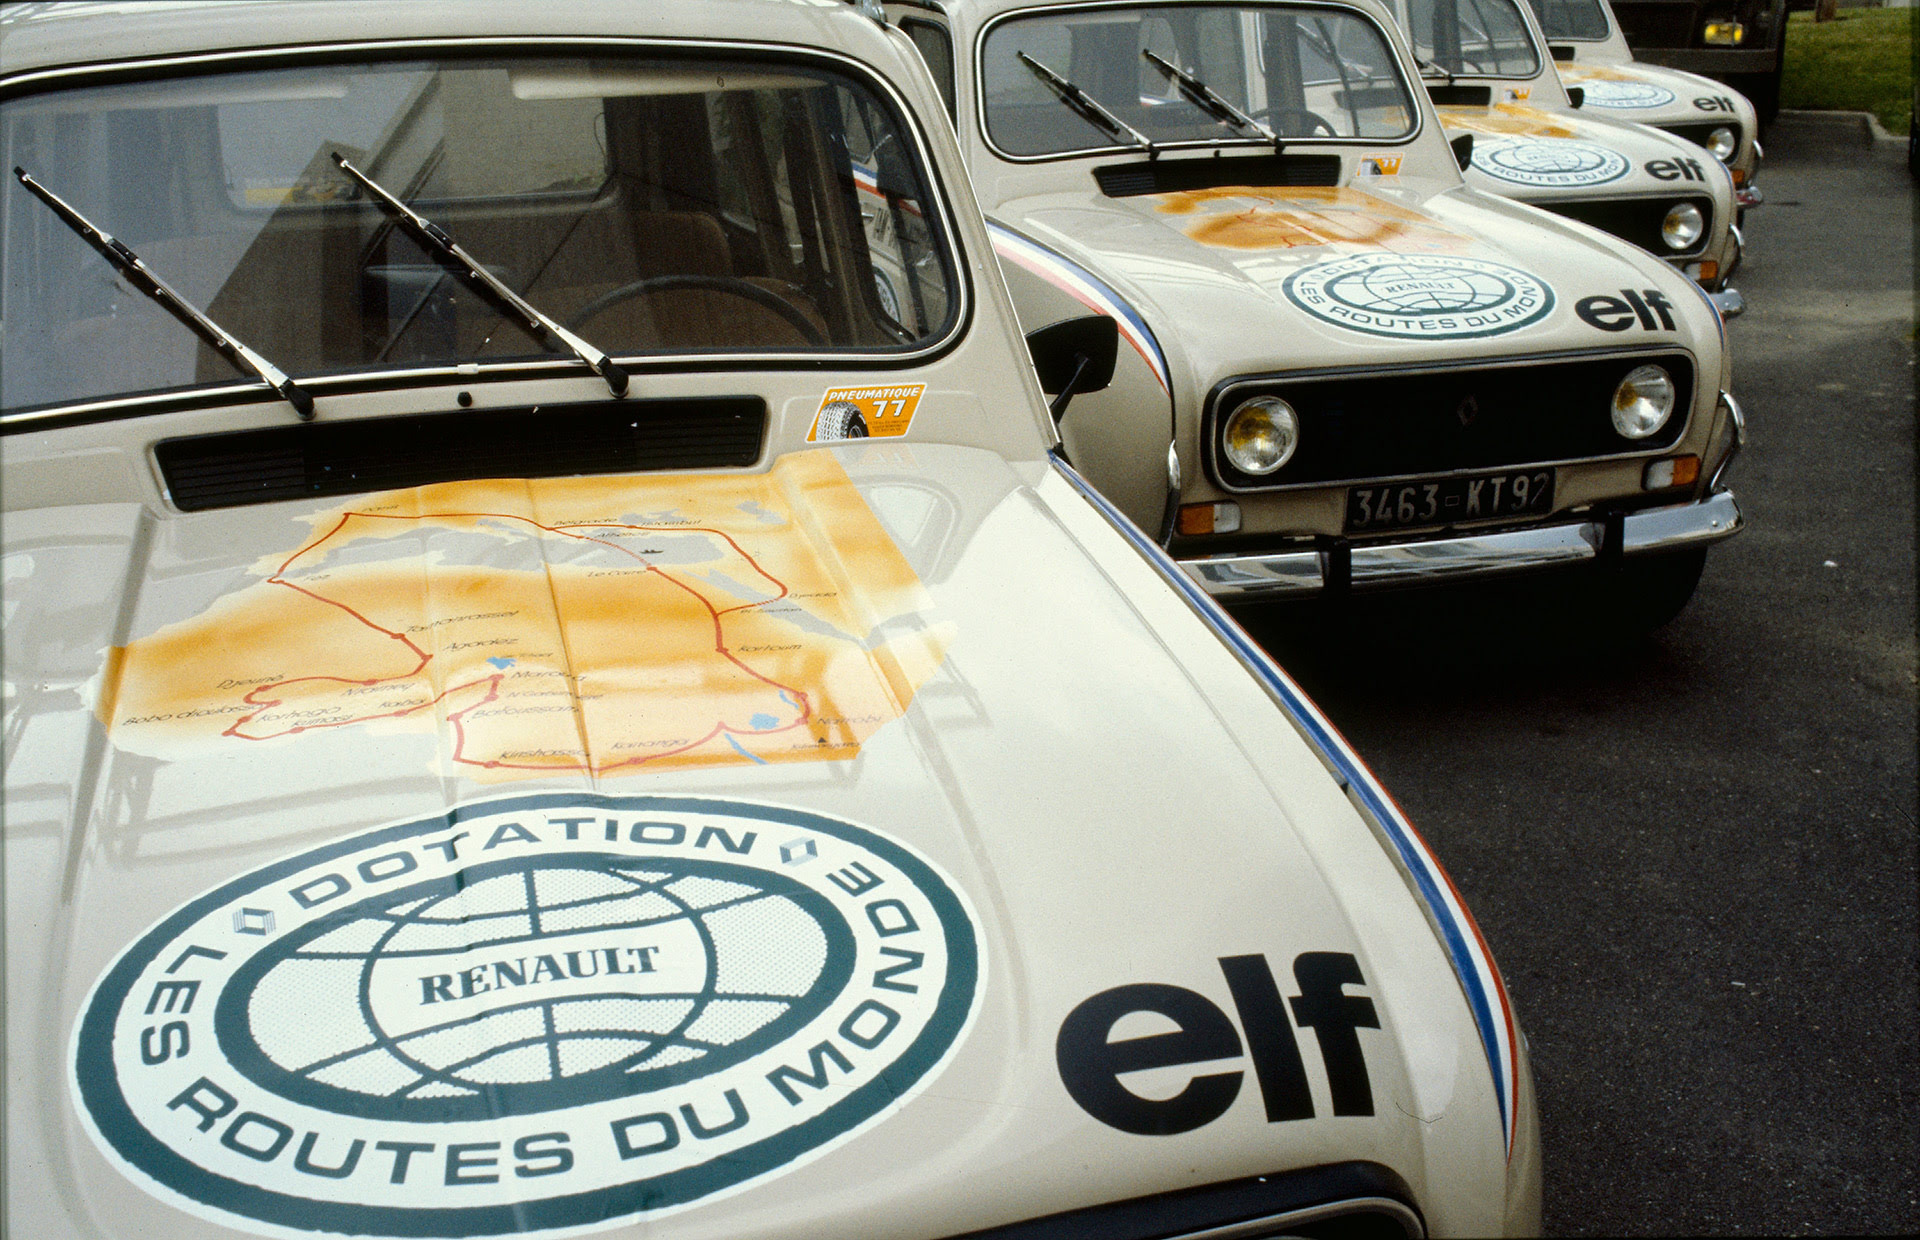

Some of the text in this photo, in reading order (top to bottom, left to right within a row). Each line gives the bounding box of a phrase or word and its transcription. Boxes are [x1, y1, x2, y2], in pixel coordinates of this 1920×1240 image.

[1693, 96, 1735, 113] elf
[1494, 167, 1570, 182] ROUTES
[1574, 173, 1597, 182] DU
[1645, 157, 1705, 182] elf
[1300, 281, 1326, 305] LES
[1329, 306, 1458, 331] ROUTES
[1466, 312, 1503, 327] DU
[1385, 281, 1457, 293] RENAULT
[1575, 289, 1678, 332] elf
[828, 387, 921, 401] PNEUMATIQUE
[872, 400, 906, 418] 77
[1352, 484, 1439, 528] 3463
[288, 817, 757, 911] DOTATION
[418, 945, 660, 1007] RENAULT
[139, 860, 926, 1187] LES ROUTES DU MONDE
[1056, 951, 1381, 1136] elf
